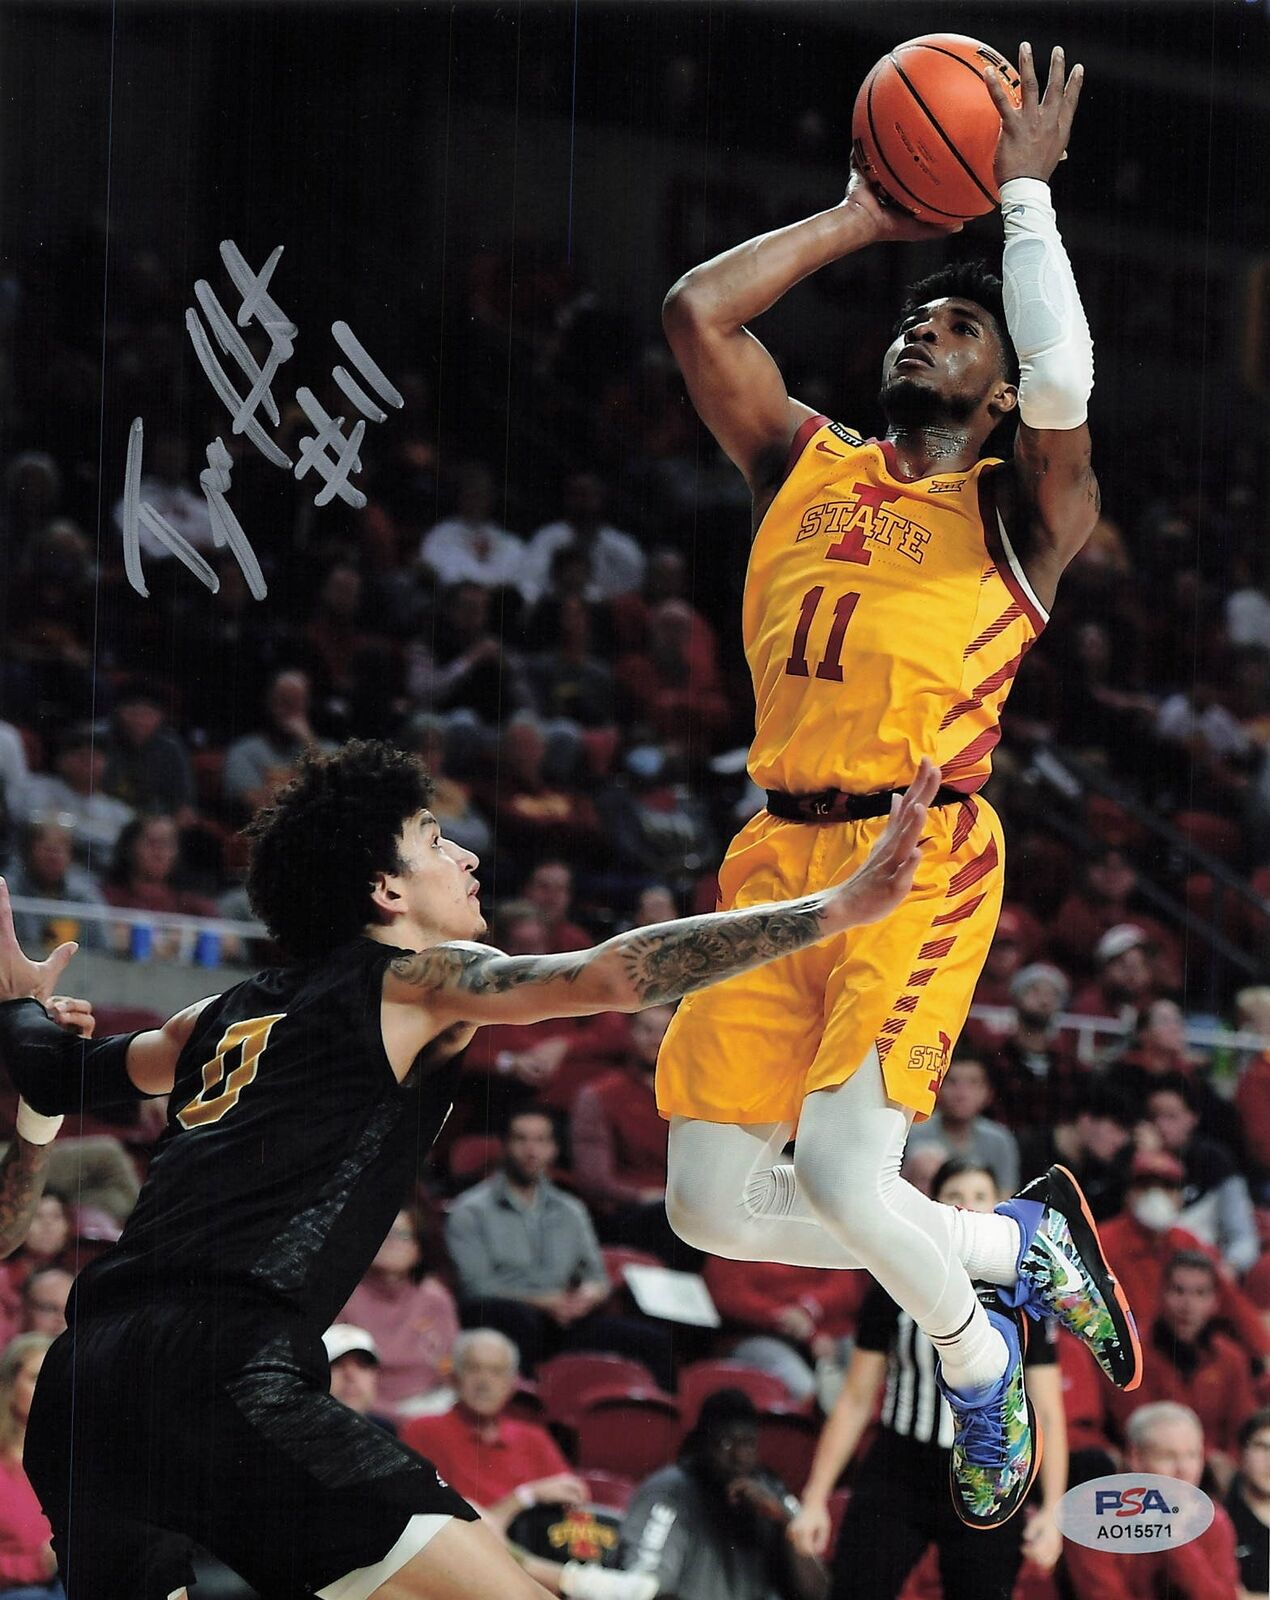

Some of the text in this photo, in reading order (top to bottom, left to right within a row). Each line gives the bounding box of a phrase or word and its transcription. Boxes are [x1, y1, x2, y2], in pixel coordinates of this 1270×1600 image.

[830, 424, 863, 446] UNITY
[795, 501, 932, 564] STATE
[785, 585, 861, 682] 11
[176, 1013, 287, 1130] 0
